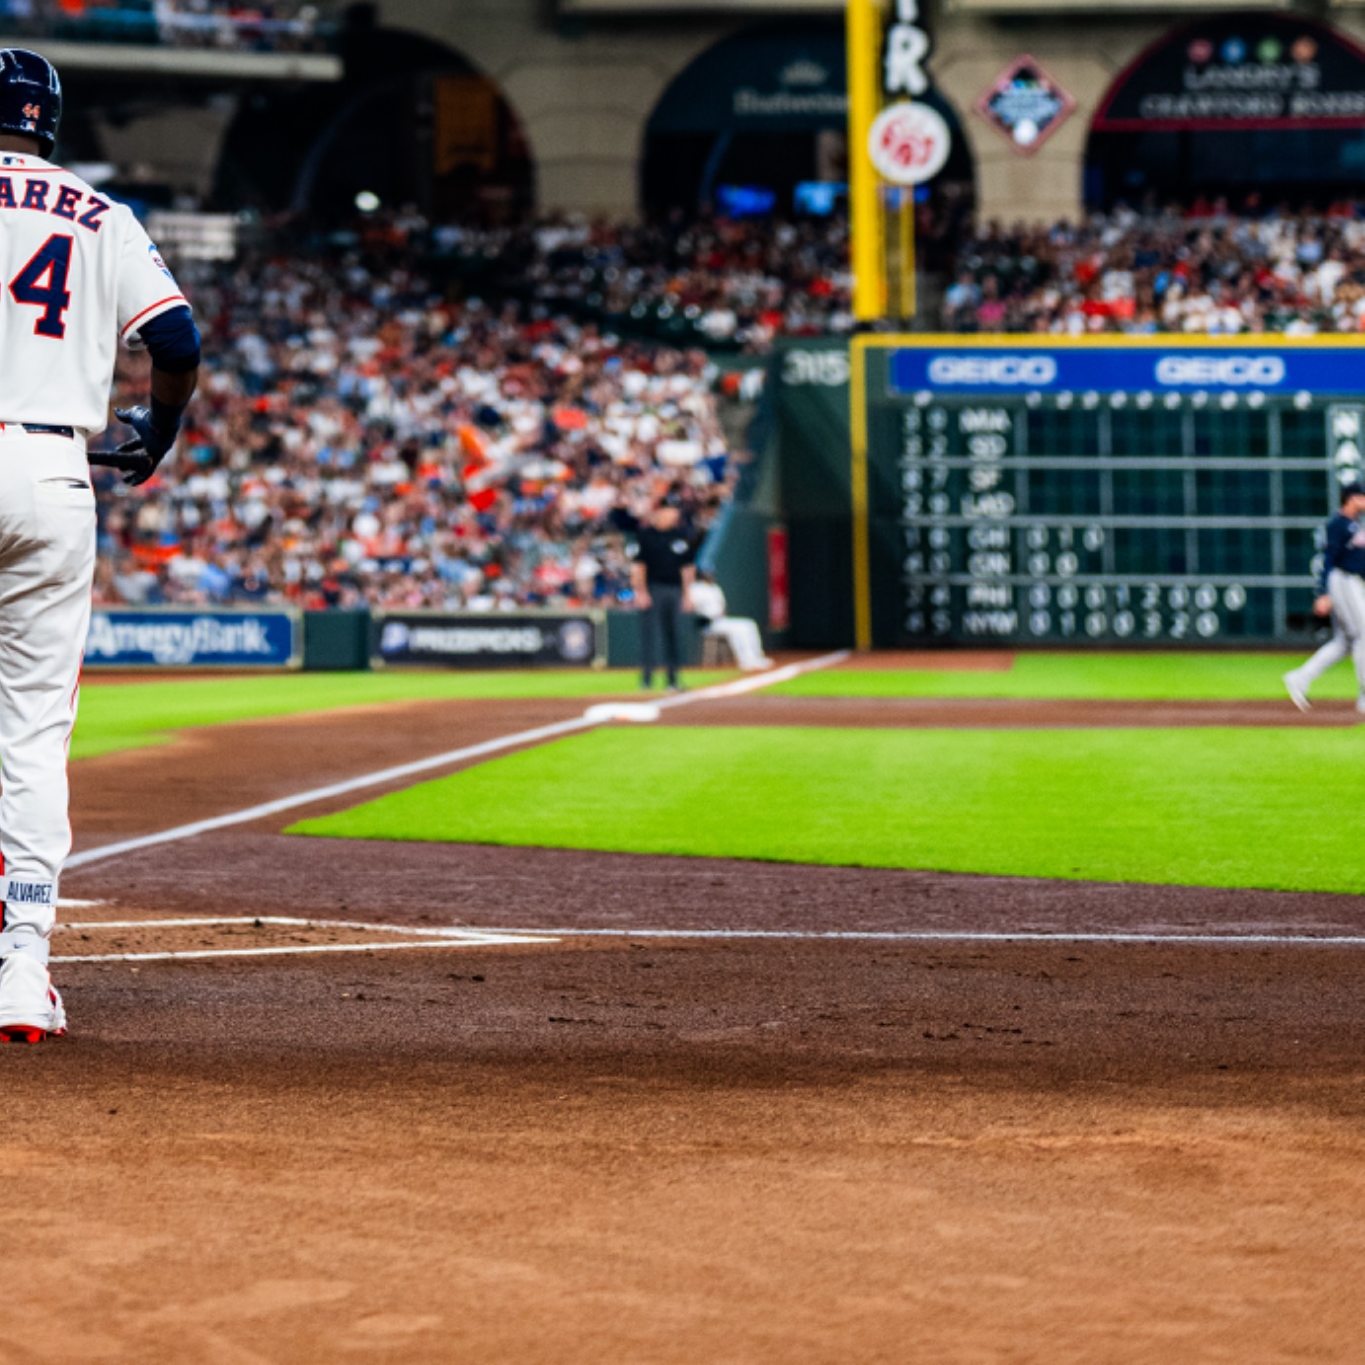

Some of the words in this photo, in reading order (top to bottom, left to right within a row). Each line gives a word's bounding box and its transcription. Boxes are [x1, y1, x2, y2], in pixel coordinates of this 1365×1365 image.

[783, 349, 849, 387] 315
[927, 355, 1057, 385] GEICO
[1155, 355, 1286, 385] GEICO
[6, 881, 53, 904] ALVAREZ
